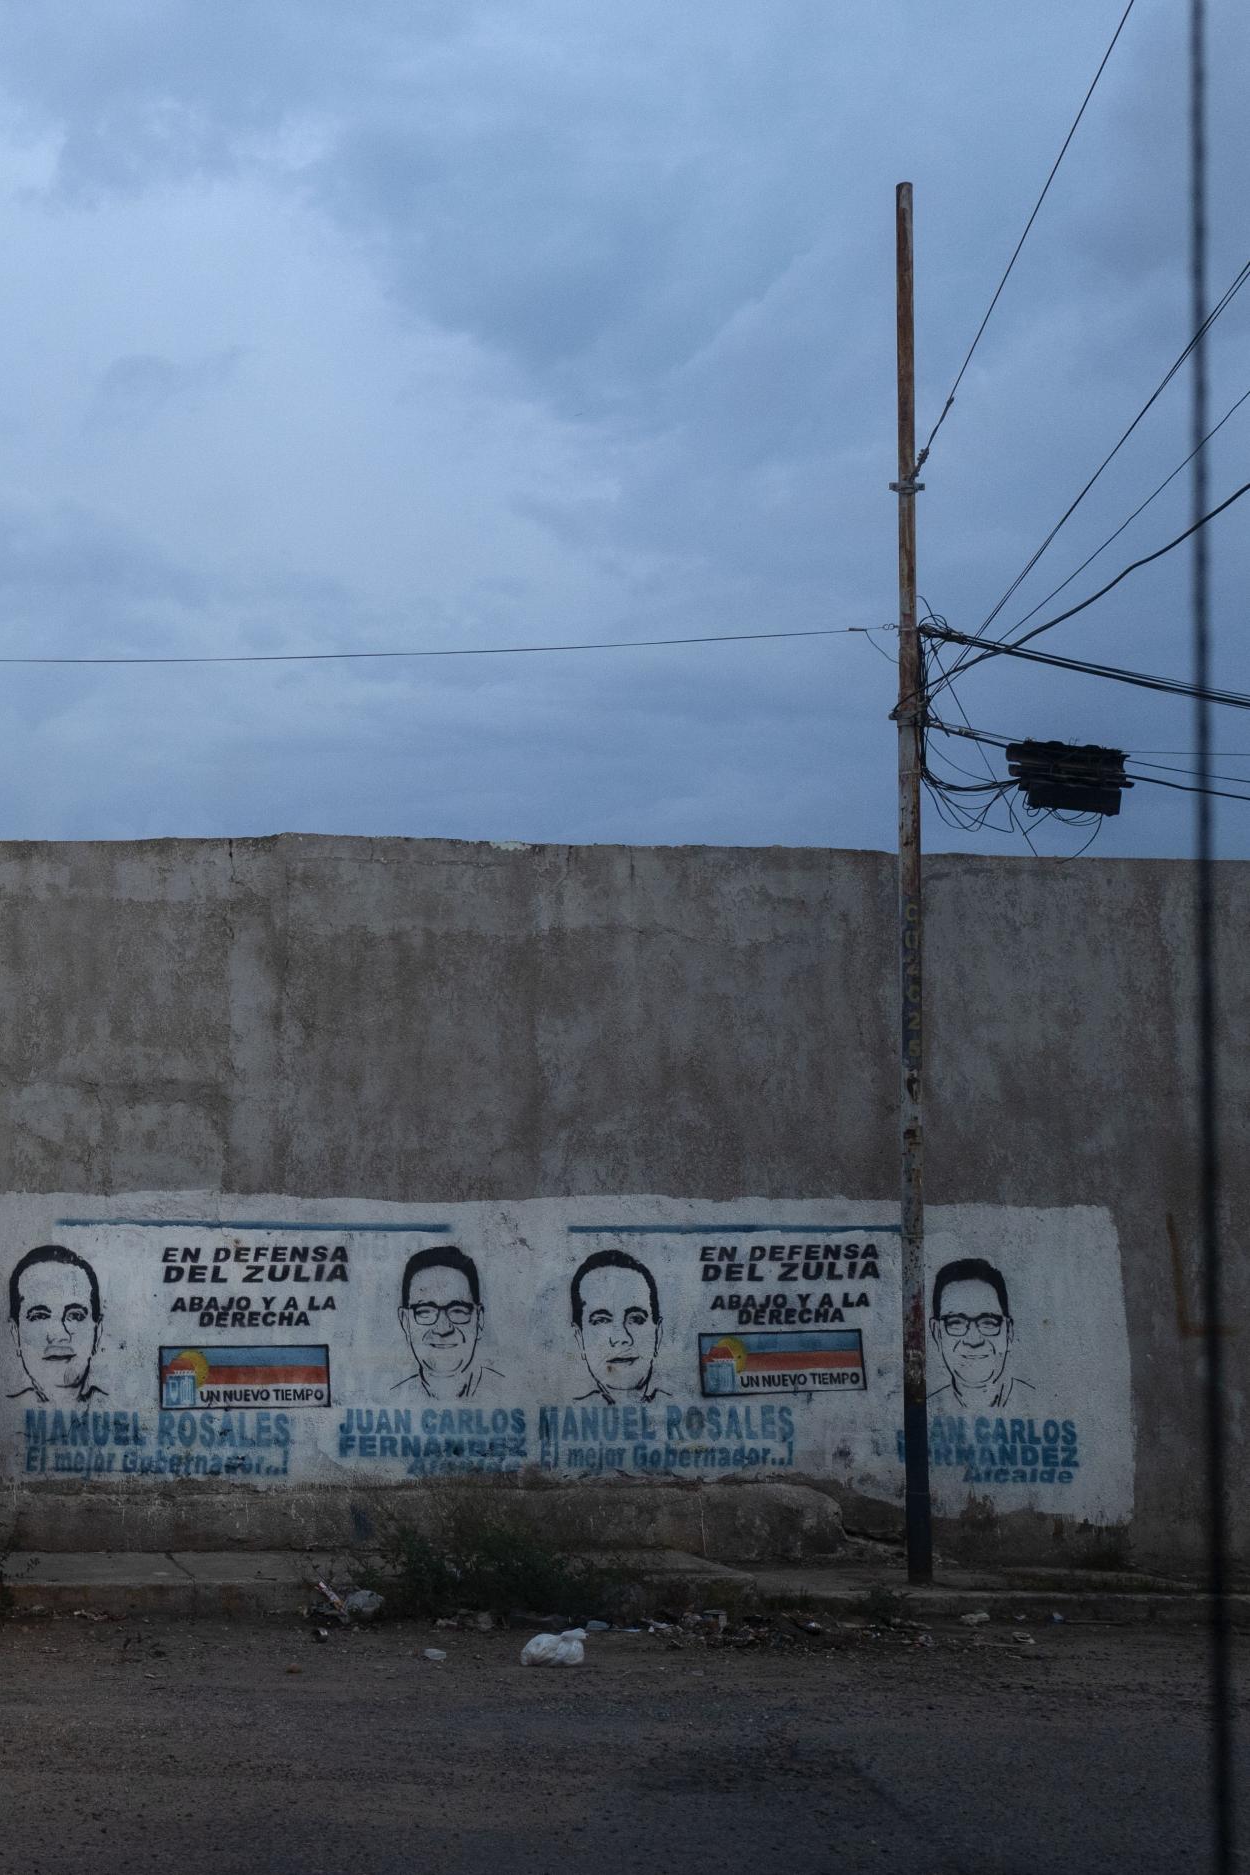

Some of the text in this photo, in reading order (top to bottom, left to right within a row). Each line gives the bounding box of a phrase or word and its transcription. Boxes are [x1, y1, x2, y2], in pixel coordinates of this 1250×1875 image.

[161, 1245, 349, 1263] EN DEFENSA
[699, 1244, 879, 1262] EN DEFENSA
[163, 1263, 349, 1283] DEL ZULIA
[701, 1261, 880, 1282] DEL ZULIA
[170, 1296, 337, 1312] ABAJO Y A LA
[710, 1292, 870, 1310] ABAJO Y A LA
[199, 1311, 311, 1327] DERECHA
[737, 1308, 845, 1325] DERECHA
[740, 1372, 860, 1388] UN NUEVO TIEMPO
[200, 1388, 324, 1402] UN NUEVO TIEMPO
[25, 1409, 291, 1447] MANUEL ROSALES
[339, 1408, 526, 1434] JUAN CARLOS
[538, 1404, 795, 1441] MANUEL ROSALES
[974, 1416, 1078, 1446] CARLOS
[962, 1466, 1074, 1484] Alcalde
